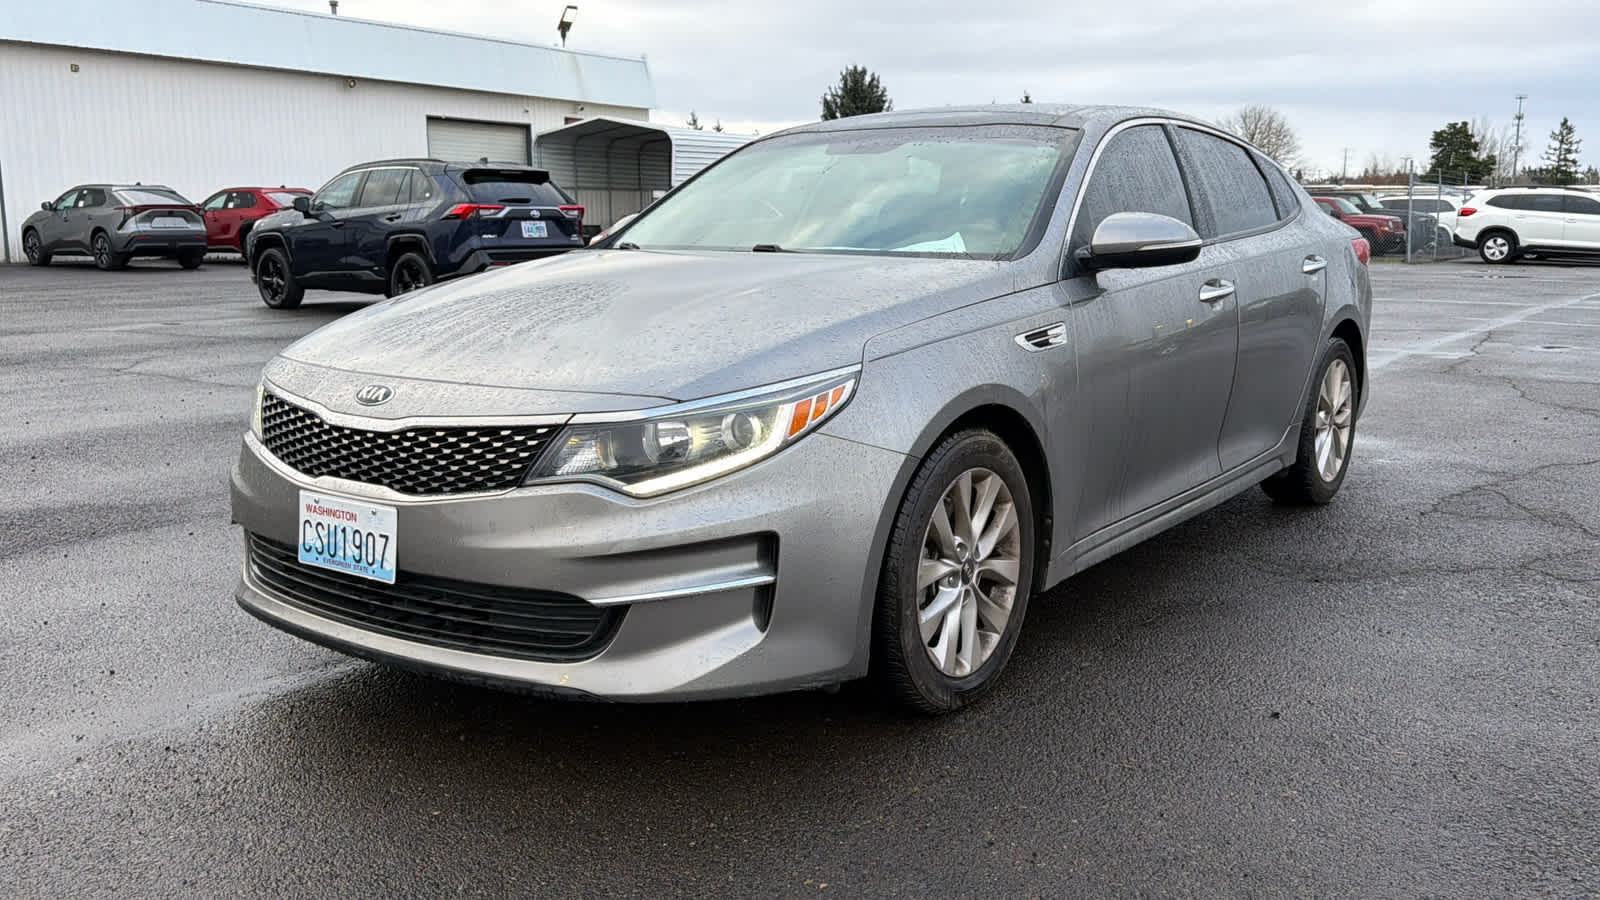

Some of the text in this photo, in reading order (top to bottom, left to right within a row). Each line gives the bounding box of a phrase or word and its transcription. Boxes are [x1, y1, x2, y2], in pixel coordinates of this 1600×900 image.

[358, 386, 386, 401] KIA
[306, 503, 357, 522] WASHINGTON
[303, 519, 389, 570] CSU1907
